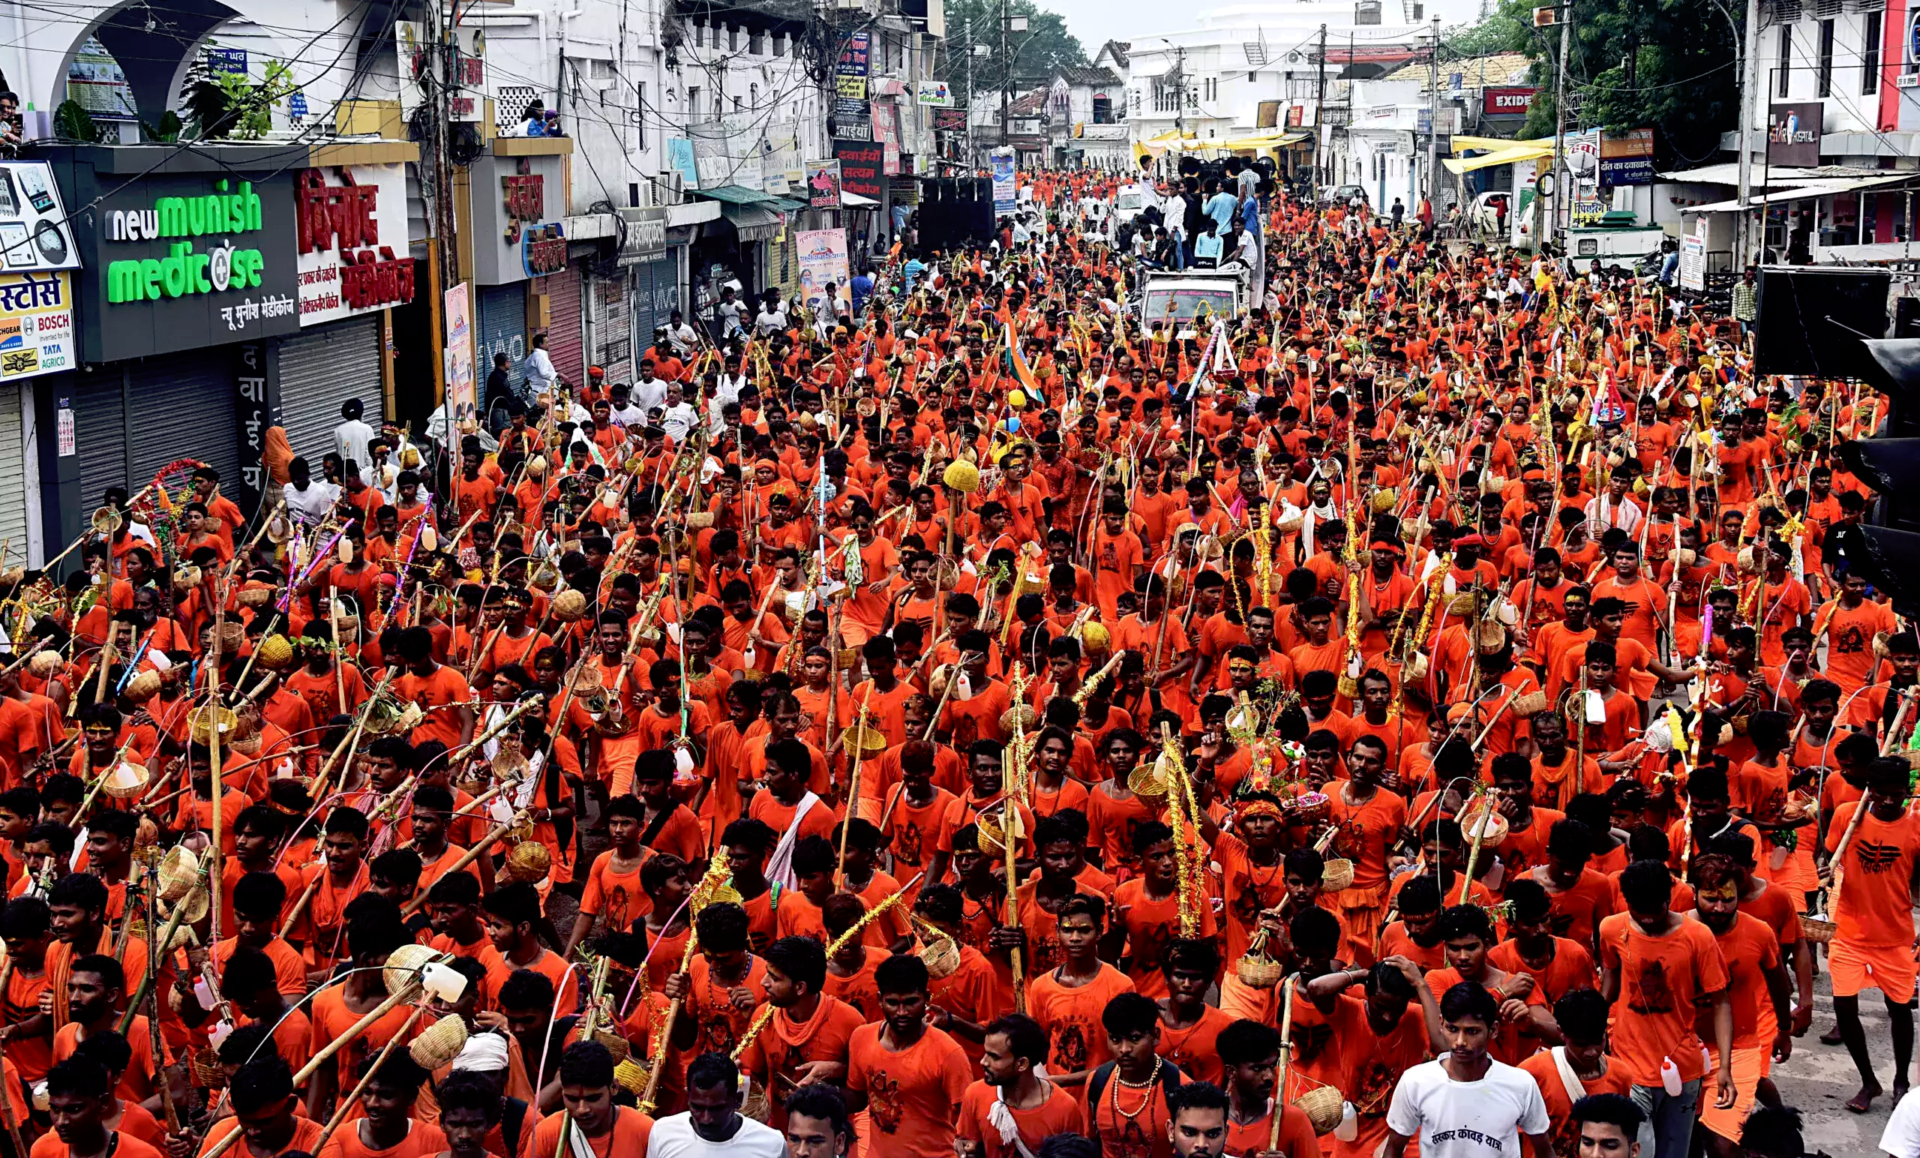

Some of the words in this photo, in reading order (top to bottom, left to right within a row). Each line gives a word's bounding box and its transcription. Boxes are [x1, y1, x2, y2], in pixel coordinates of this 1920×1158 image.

[1496, 95, 1532, 106] EXIDE
[109, 210, 159, 241] new
[156, 178, 262, 237] munish
[221, 307, 237, 331] न्यू
[236, 298, 259, 330] मुनीश
[261, 293, 295, 318] मेडीकोज
[38, 314, 70, 331] BOSCH
[43, 344, 61, 355] TATA
[42, 356, 65, 369] AGRICO
[1485, 1135, 1503, 1151] यात्रा
